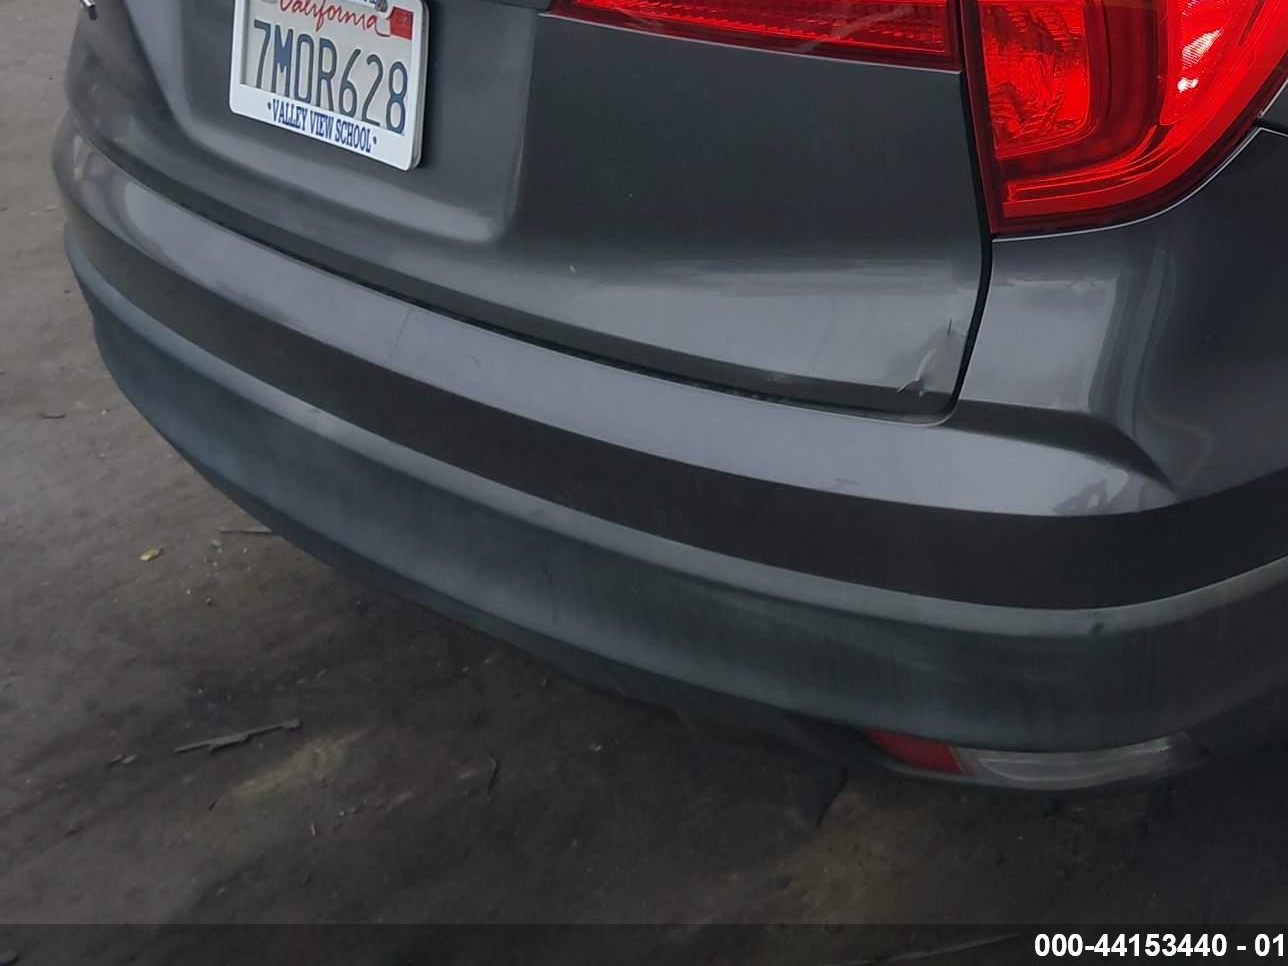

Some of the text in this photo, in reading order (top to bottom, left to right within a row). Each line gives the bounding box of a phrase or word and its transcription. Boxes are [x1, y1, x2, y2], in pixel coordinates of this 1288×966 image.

[253, 19, 409, 135] 7MOR628
[272, 98, 373, 153] VALLEY VIEW SCHOOL
